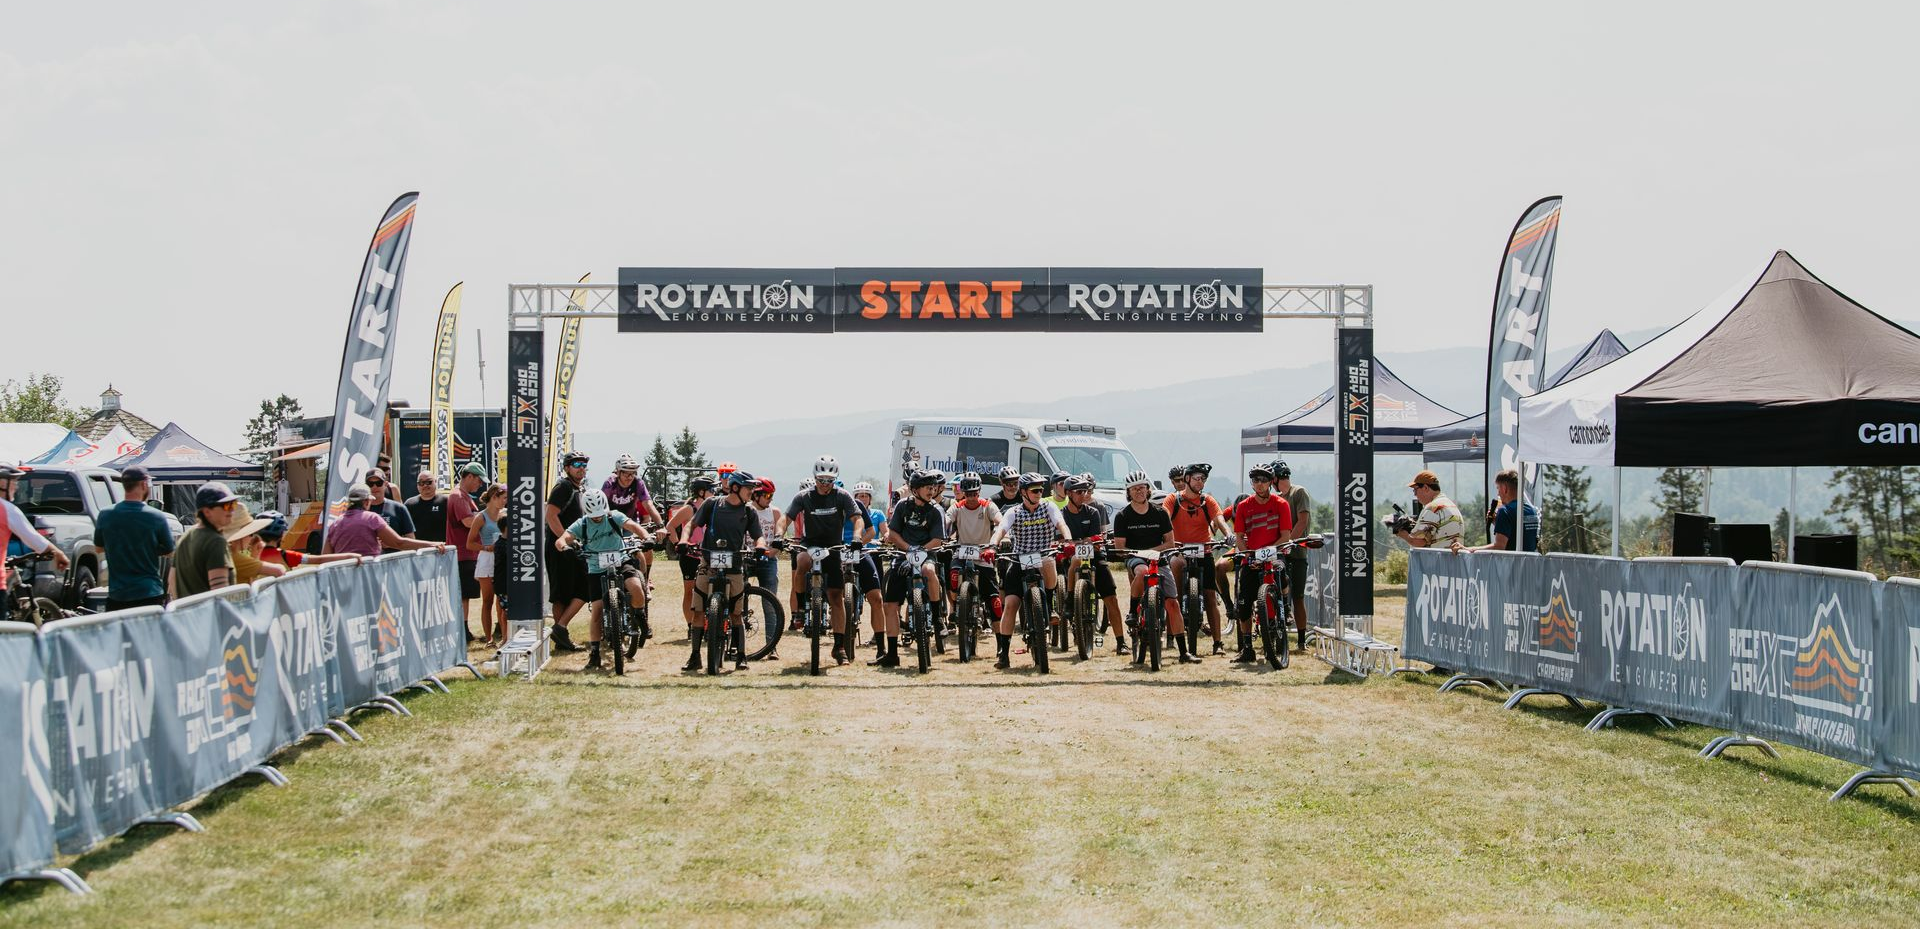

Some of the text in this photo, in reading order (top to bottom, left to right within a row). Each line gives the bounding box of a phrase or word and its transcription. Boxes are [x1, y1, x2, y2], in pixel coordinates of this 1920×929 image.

[637, 280, 814, 321] ROTATION
[861, 280, 1023, 319] START
[1068, 279, 1243, 321] ROTATION
[672, 313, 814, 322] ENGINEERING
[1102, 313, 1243, 322] ENGINEERING
[339, 252, 396, 484] START
[438, 315, 456, 399] PODIUM
[517, 369, 528, 396] DAY
[528, 361, 538, 396] RACE
[1349, 367, 1359, 393] DAY
[1360, 359, 1369, 394] RACE
[517, 396, 538, 435] XC
[1349, 394, 1369, 431] XC
[938, 427, 983, 437] AMBULANCE
[1569, 420, 1611, 445] cannondale
[1858, 422, 1920, 444] can
[924, 455, 1006, 475] Lyndon Rescue
[512, 477, 539, 582] ROTATION
[1345, 473, 1370, 578] ROTATION
[606, 553, 615, 563] 14
[1261, 549, 1271, 558] 32
[1416, 569, 1489, 646] ROTATION
[1600, 582, 1707, 682] ROTATION
